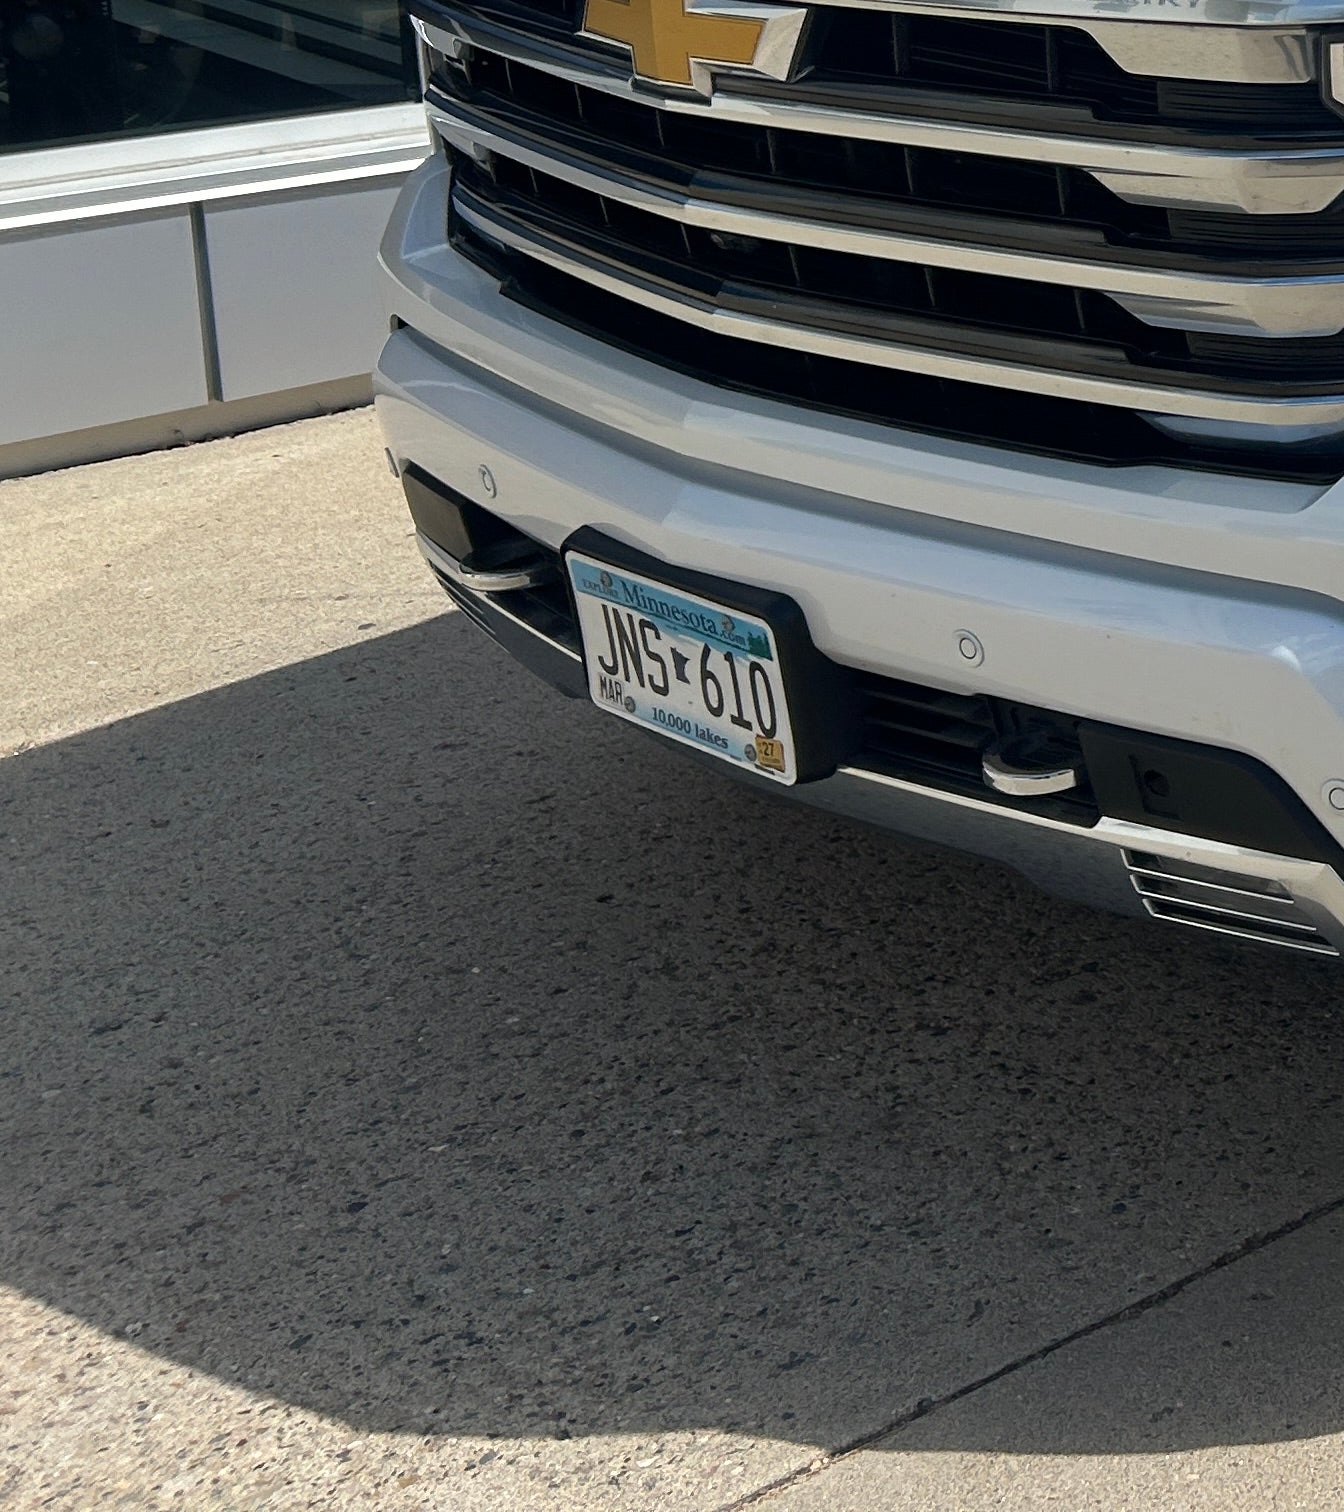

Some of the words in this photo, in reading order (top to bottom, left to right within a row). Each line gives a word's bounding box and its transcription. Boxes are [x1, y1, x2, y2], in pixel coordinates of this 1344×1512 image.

[598, 603, 669, 697] JNS
[700, 642, 777, 739] 610
[599, 674, 623, 706] MAR
[652, 706, 691, 734] 10,000
[695, 723, 729, 749] lakes
[763, 741, 775, 758] 27
